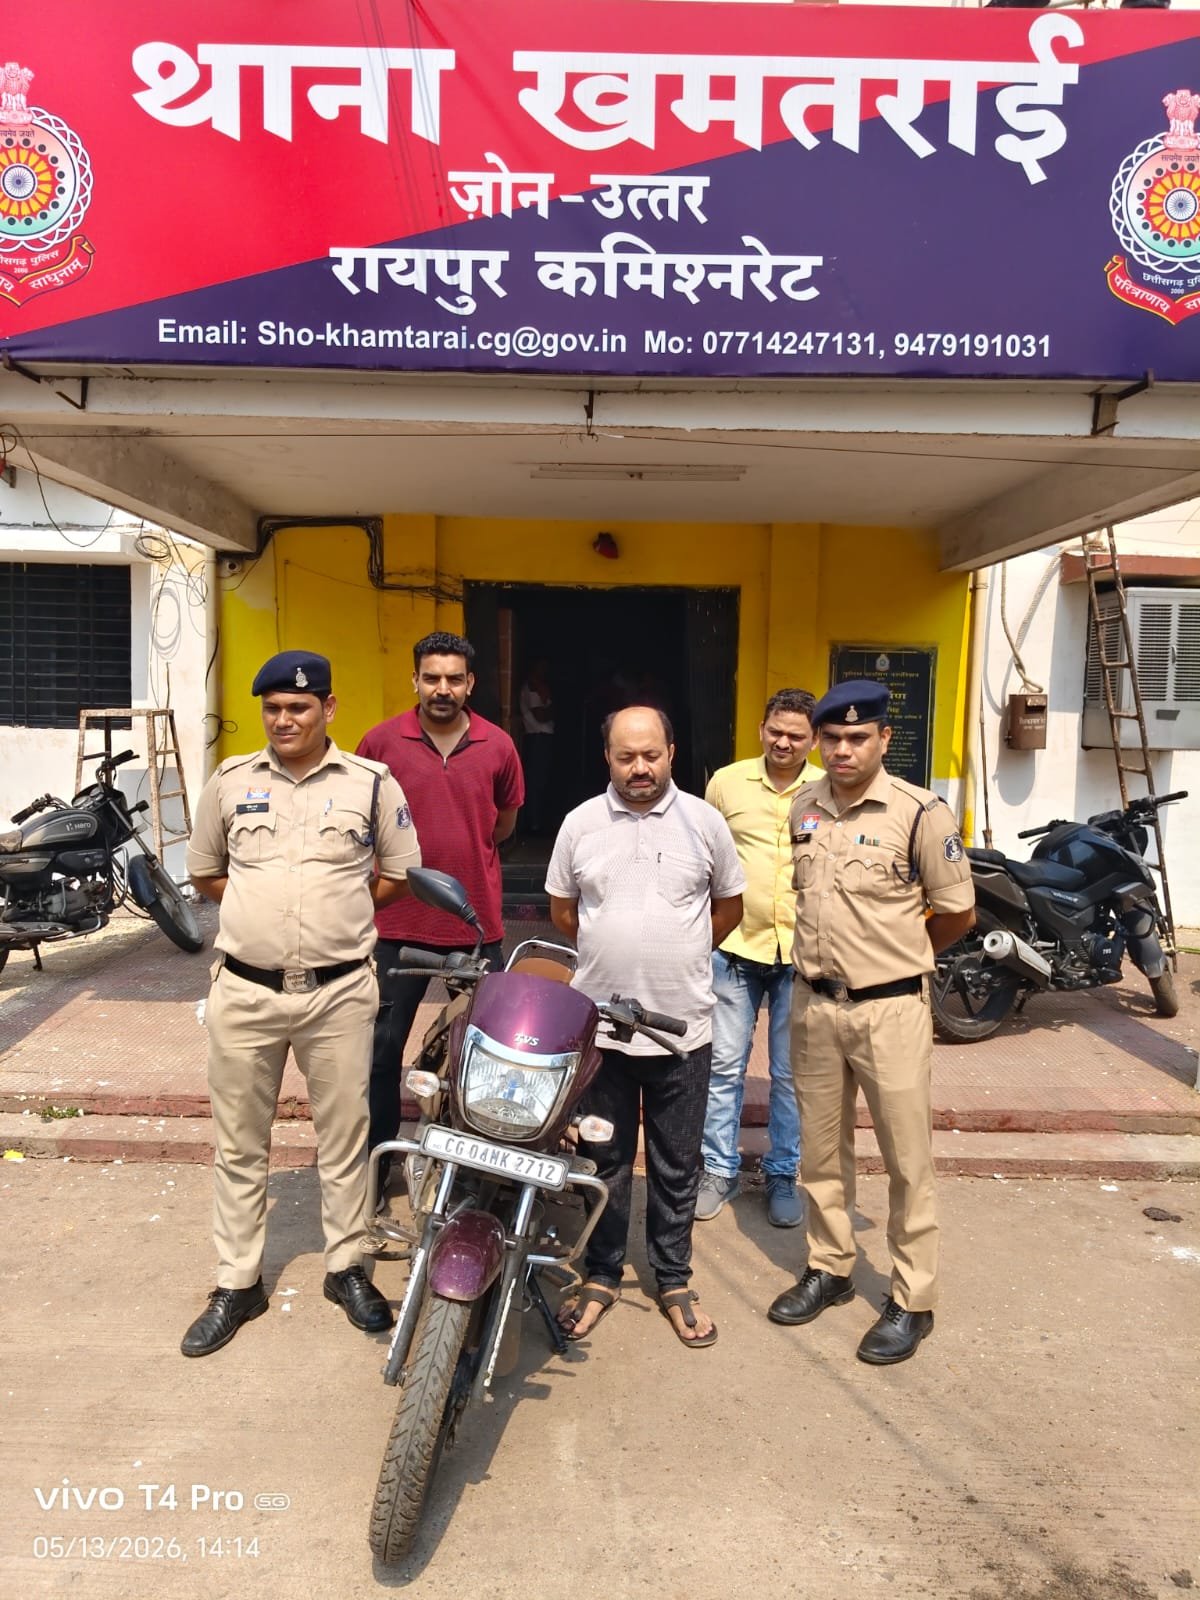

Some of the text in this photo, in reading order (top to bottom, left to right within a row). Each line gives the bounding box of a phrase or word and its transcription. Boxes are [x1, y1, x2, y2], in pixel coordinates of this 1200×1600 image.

[132, 13, 1085, 185] थाना खमतराई
[31, 250, 59, 266] पुलिस
[330, 232, 823, 315] रायपुर कमिश्नरेट
[1114, 274, 1170, 313] परित्राणाय
[158, 319, 1050, 359] Email: Sho-khamtarai.cg@gov.in Mo: 07714247131, 9479191031
[513, 1033, 541, 1046] TVS
[514, 1157, 556, 1181] 2712
